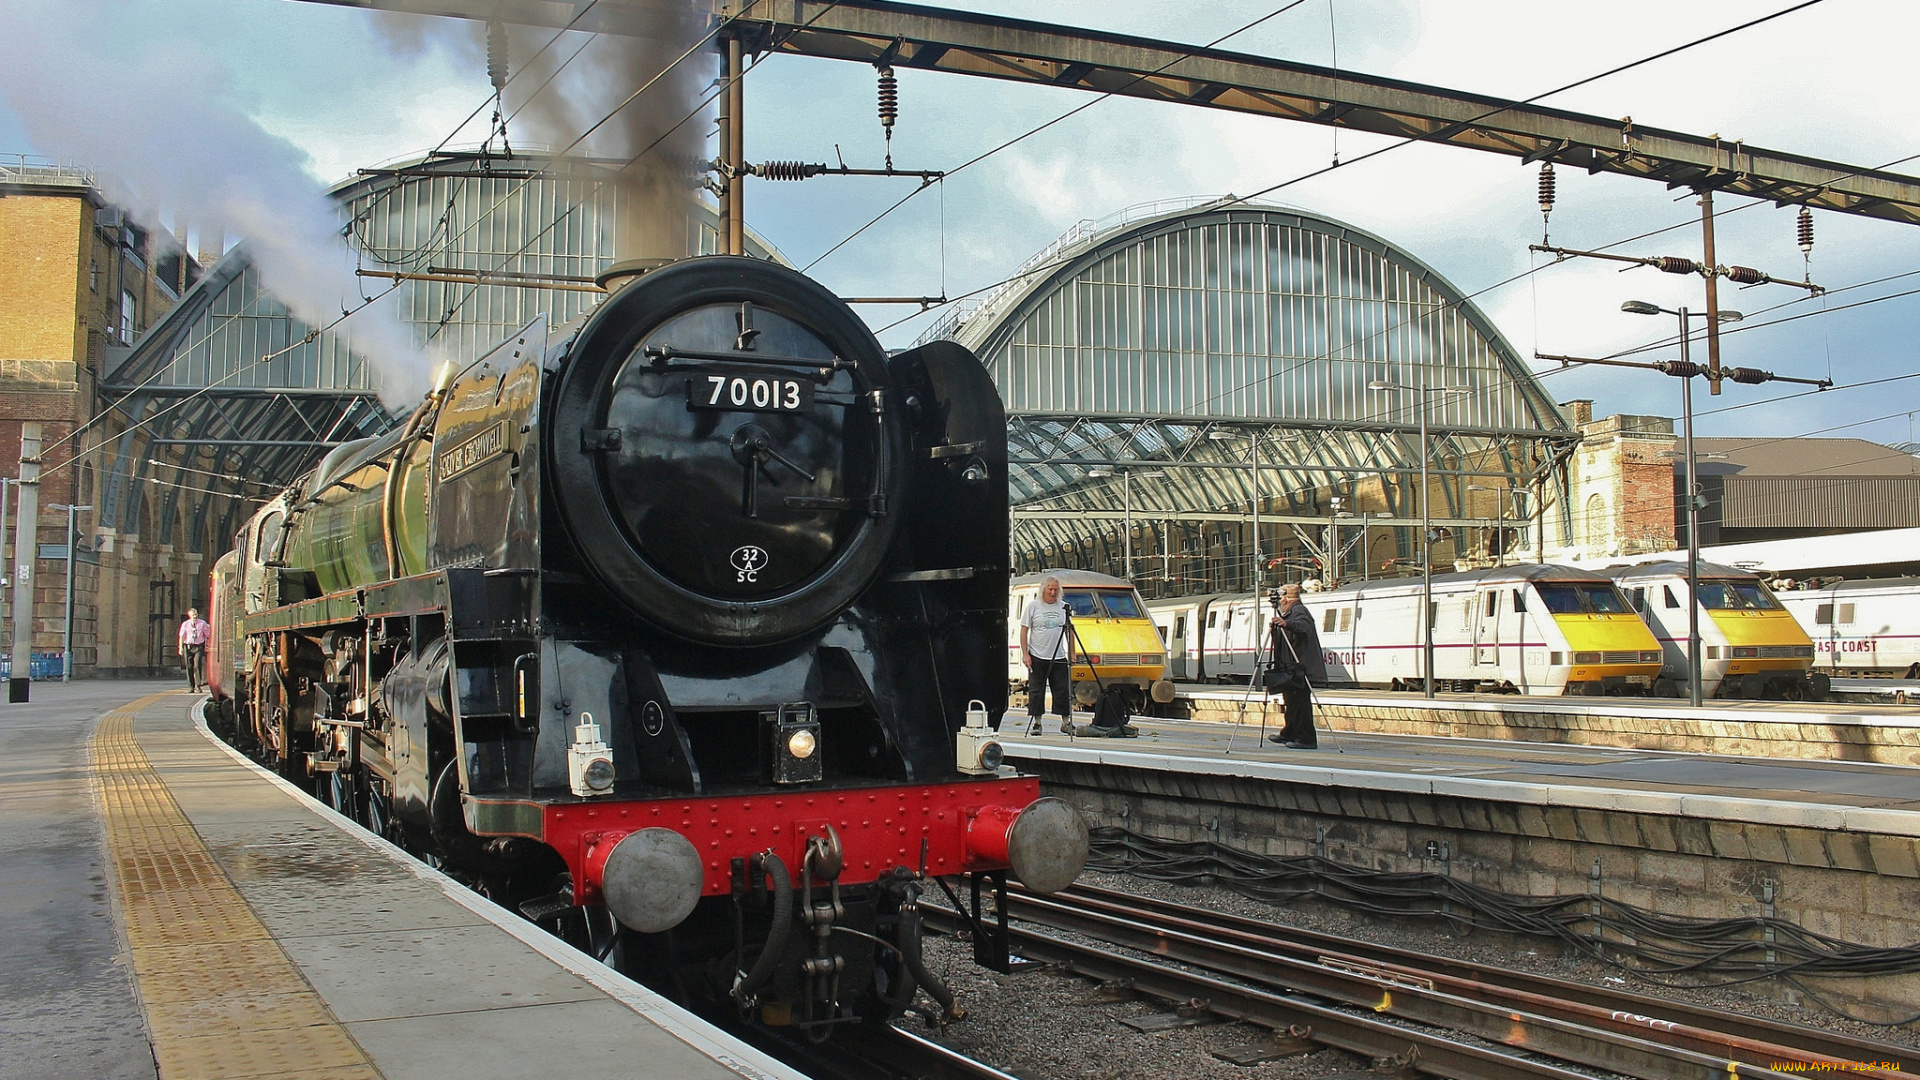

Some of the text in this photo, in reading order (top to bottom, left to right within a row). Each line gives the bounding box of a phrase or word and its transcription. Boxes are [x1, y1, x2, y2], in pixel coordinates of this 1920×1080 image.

[708, 376, 800, 409] 70013
[742, 549, 758, 561] 32
[745, 560, 753, 570] A
[737, 571, 757, 582] SC
[1842, 640, 1877, 652] COAST
[1323, 652, 1366, 665] AST COAST
